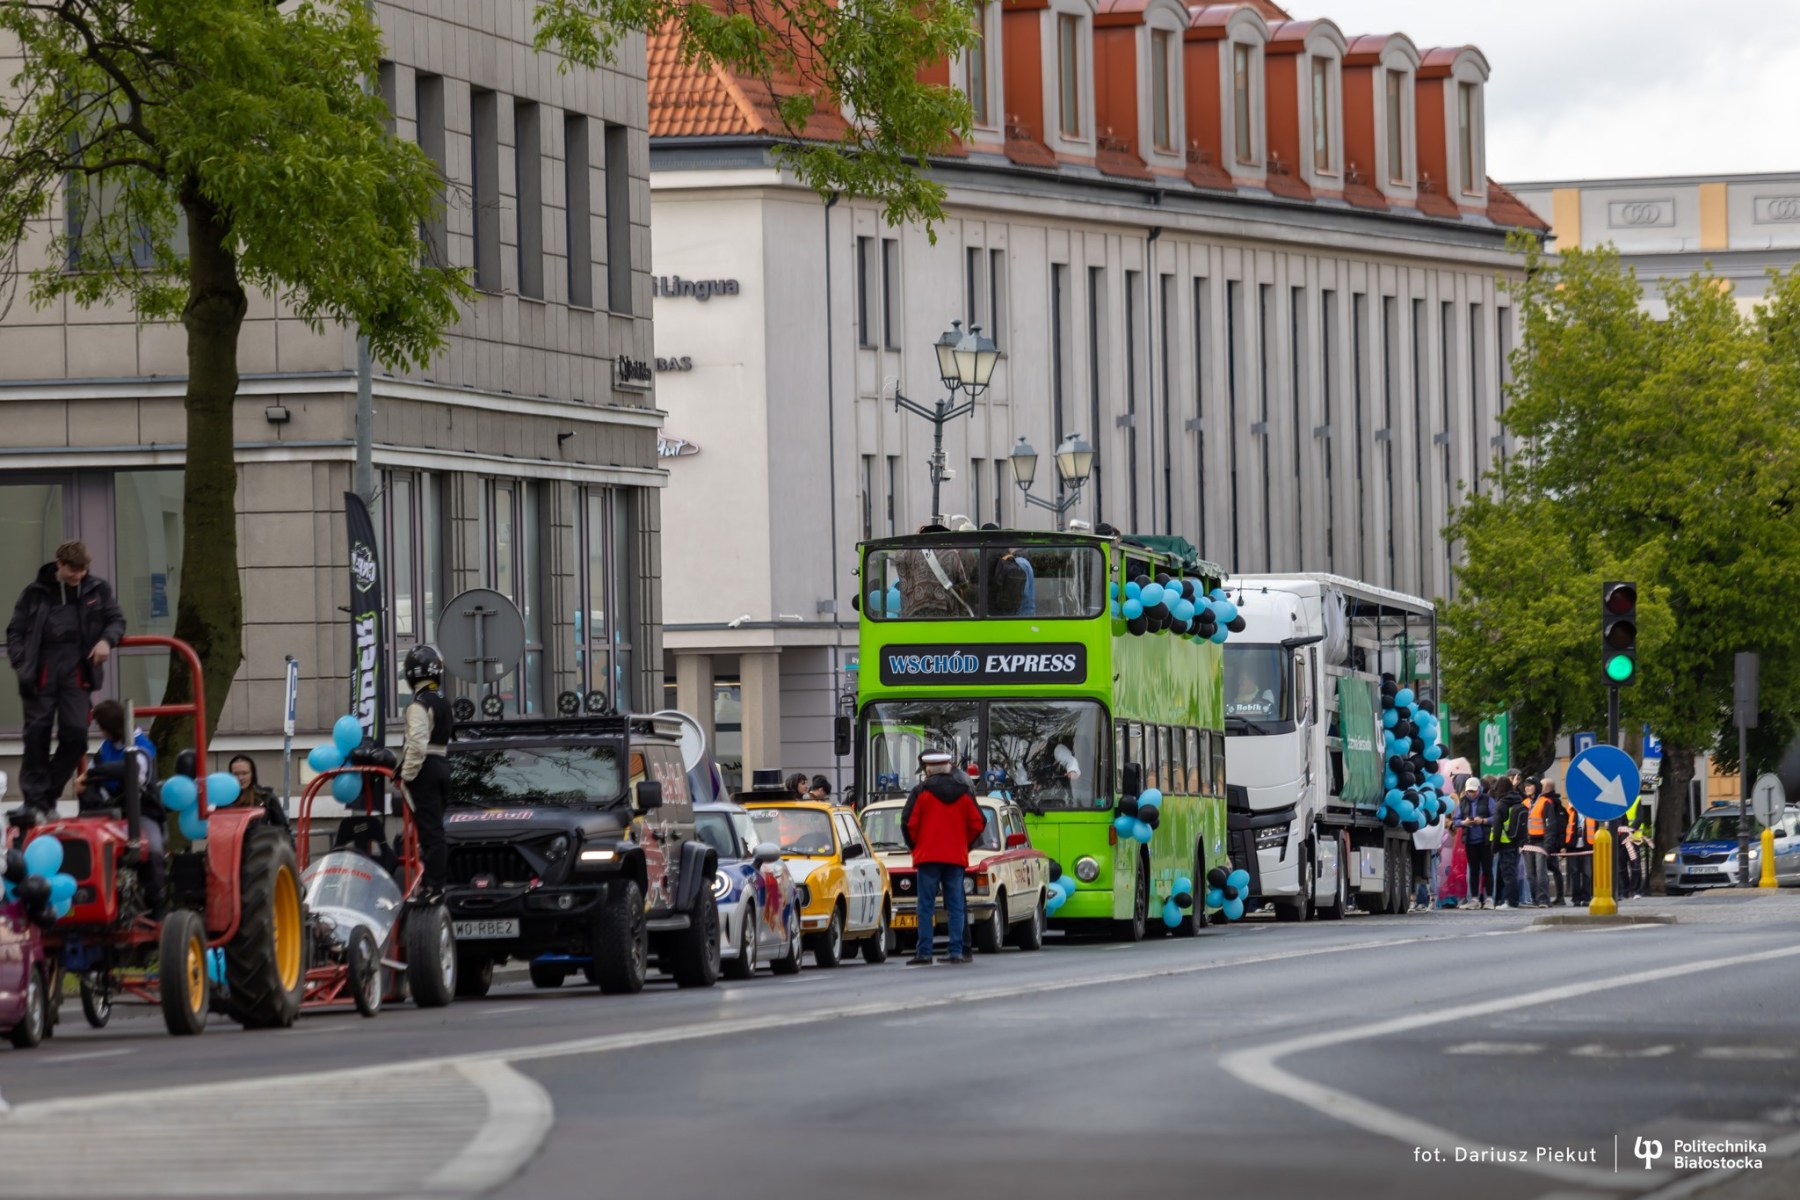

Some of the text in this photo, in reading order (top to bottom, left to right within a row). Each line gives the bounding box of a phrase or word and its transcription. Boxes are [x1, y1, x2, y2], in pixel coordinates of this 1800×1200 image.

[660, 275, 739, 301] Lingua
[889, 651, 1076, 674] WSCHÓD EXPRESS
[478, 921, 513, 935] RBE2
